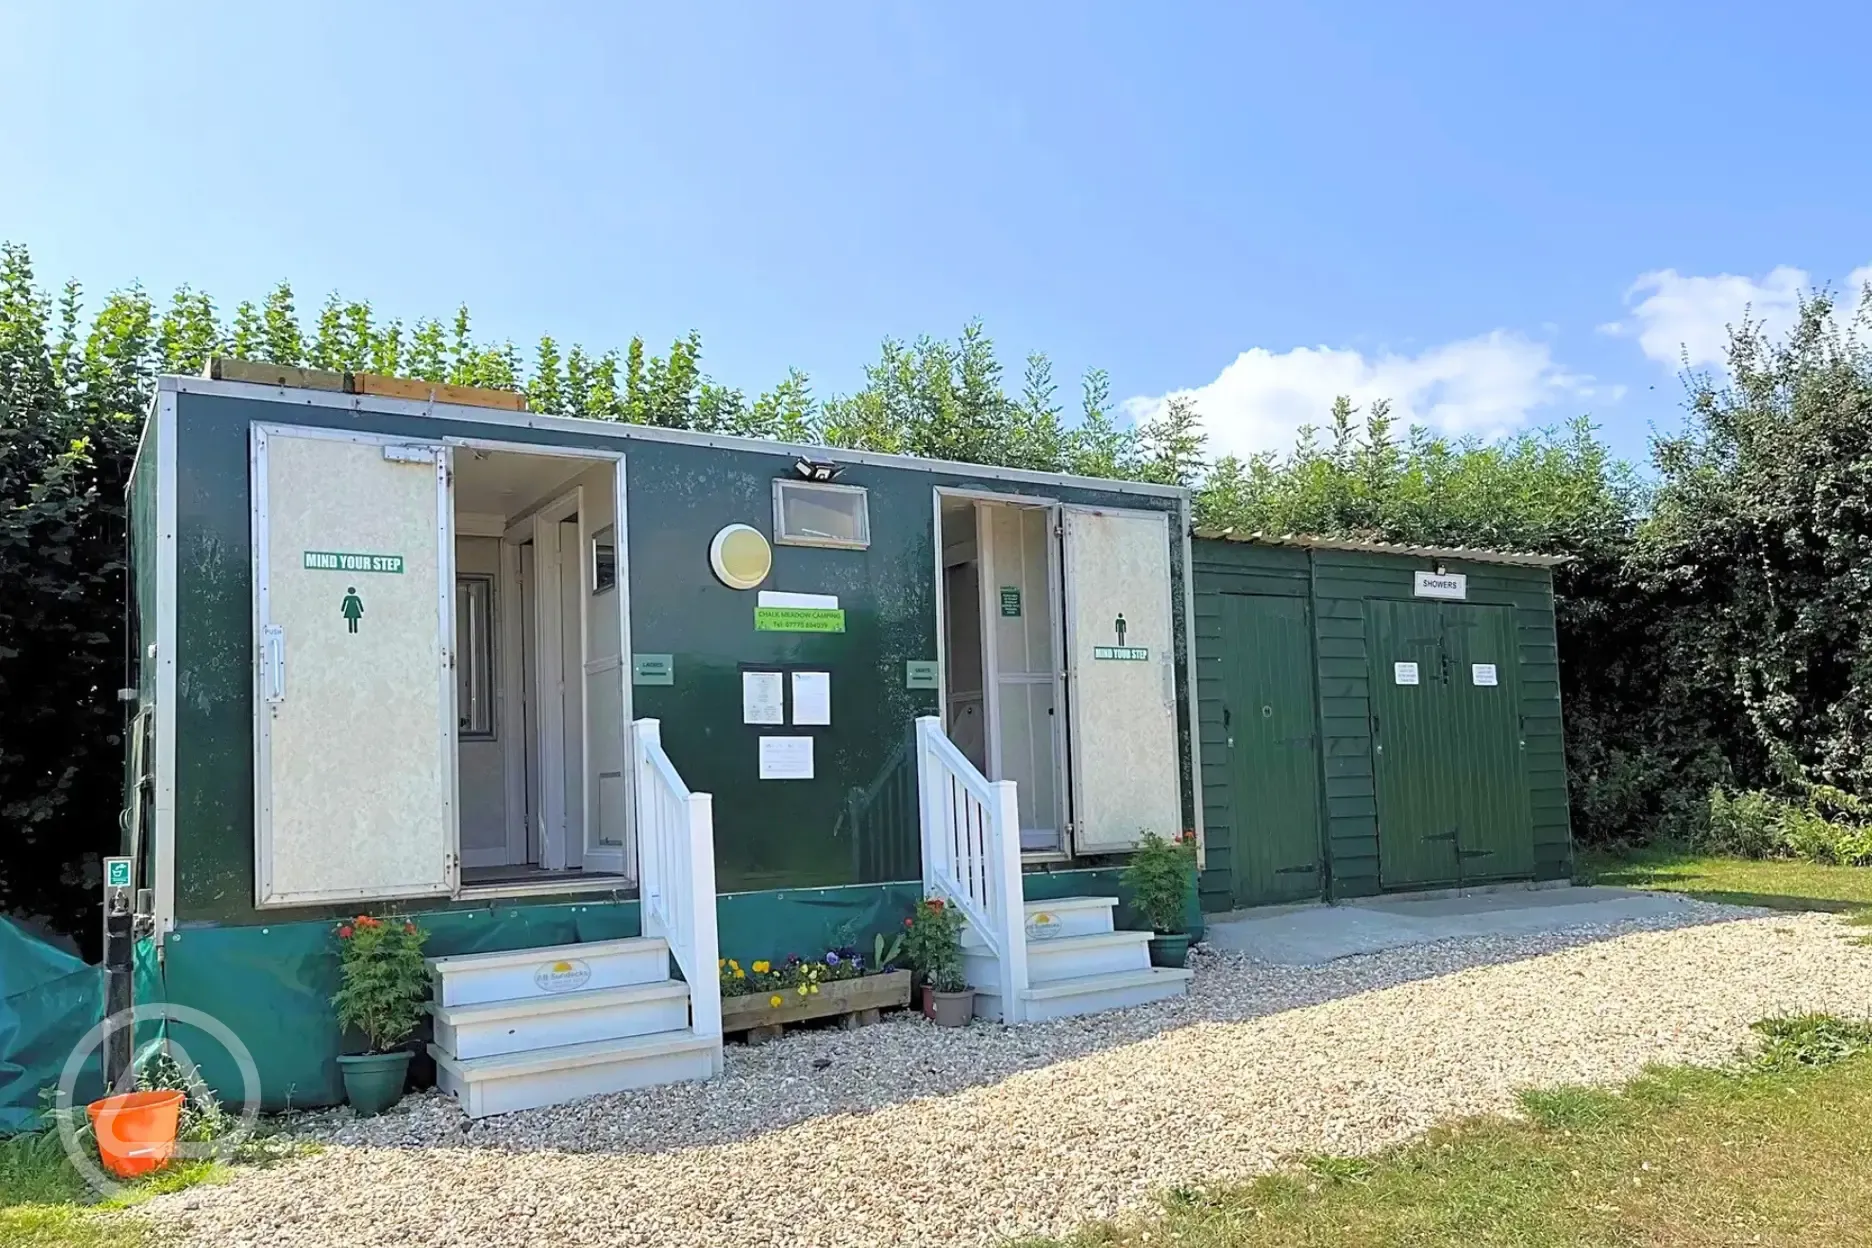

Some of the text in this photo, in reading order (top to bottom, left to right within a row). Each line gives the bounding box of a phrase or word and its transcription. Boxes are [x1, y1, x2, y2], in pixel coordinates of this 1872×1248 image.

[305, 553, 401, 571] MIND YOUR STEP
[1423, 579, 1457, 590] SHOWERS
[781, 611, 811, 619] MEADOW
[812, 612, 841, 620] CAMPING
[1113, 648, 1131, 659] YOUR
[1131, 649, 1147, 659] STEP
